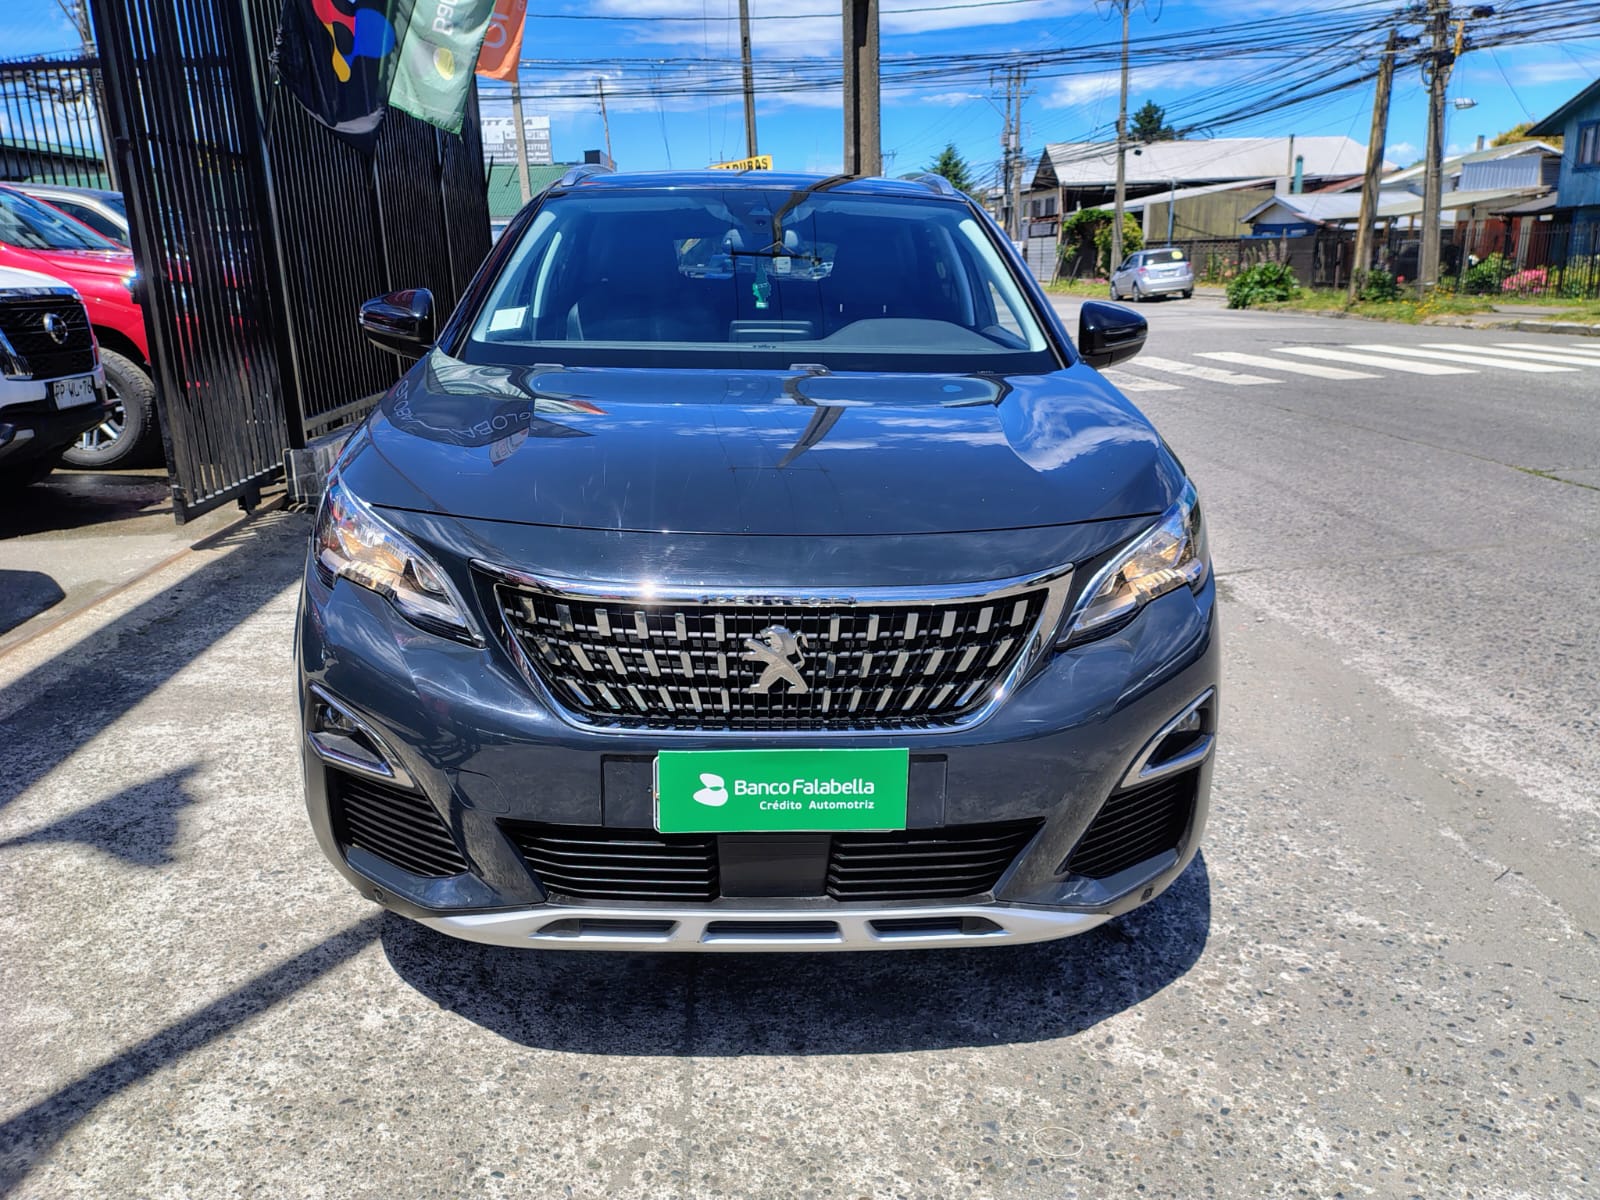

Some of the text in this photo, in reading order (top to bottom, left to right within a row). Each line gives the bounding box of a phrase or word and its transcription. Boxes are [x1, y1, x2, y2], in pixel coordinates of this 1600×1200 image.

[715, 595, 841, 608] PEUGEOT
[759, 800, 875, 810] Crédito Automotriz
